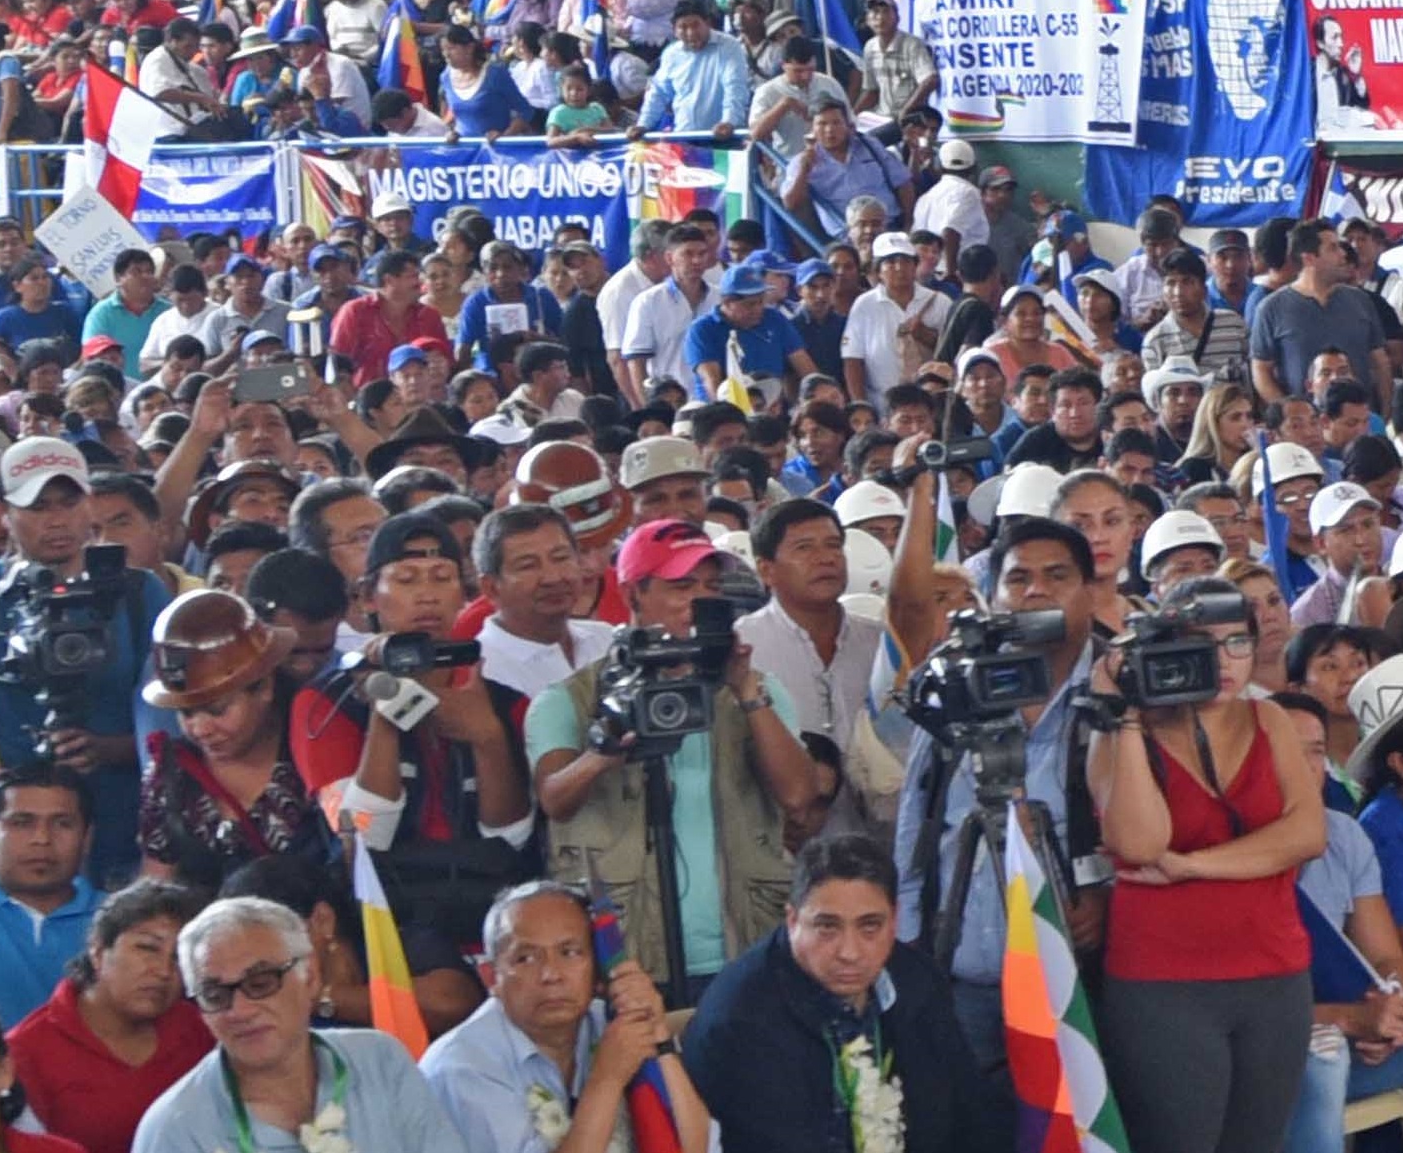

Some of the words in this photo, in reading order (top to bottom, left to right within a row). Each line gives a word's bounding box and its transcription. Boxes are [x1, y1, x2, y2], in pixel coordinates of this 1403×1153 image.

[947, 13, 1041, 38] CORDILLERA
[1184, 155, 1285, 179] EVO
[367, 163, 530, 203] MAGISTERIO
[625, 163, 661, 199] DE
